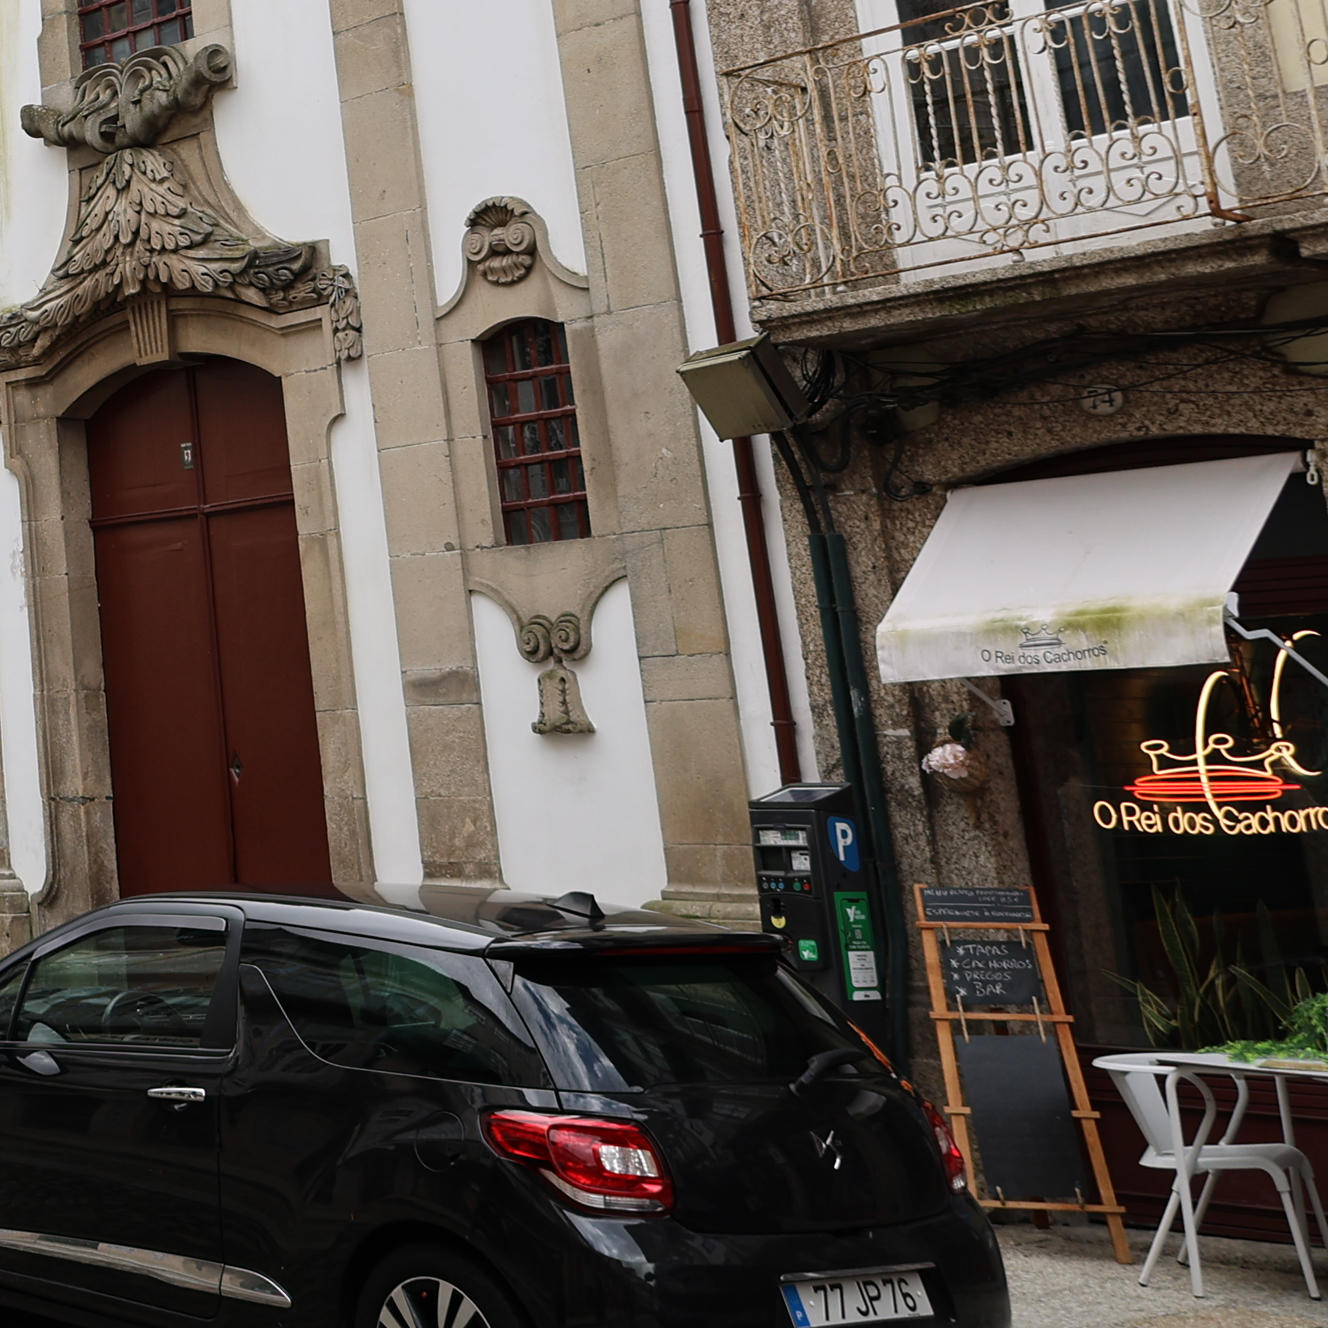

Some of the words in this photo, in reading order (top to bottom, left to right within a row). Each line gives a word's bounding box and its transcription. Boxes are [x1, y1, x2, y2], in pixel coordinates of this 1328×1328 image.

[981, 649, 991, 662] O
[995, 650, 1015, 664] Rei
[1018, 652, 1040, 665] dos
[1044, 644, 1108, 664] Cachorros
[1093, 801, 1118, 829] O
[1120, 802, 1163, 833] Rei
[1168, 805, 1215, 835] dos
[835, 822, 853, 861] P
[973, 981, 1006, 997] BAR
